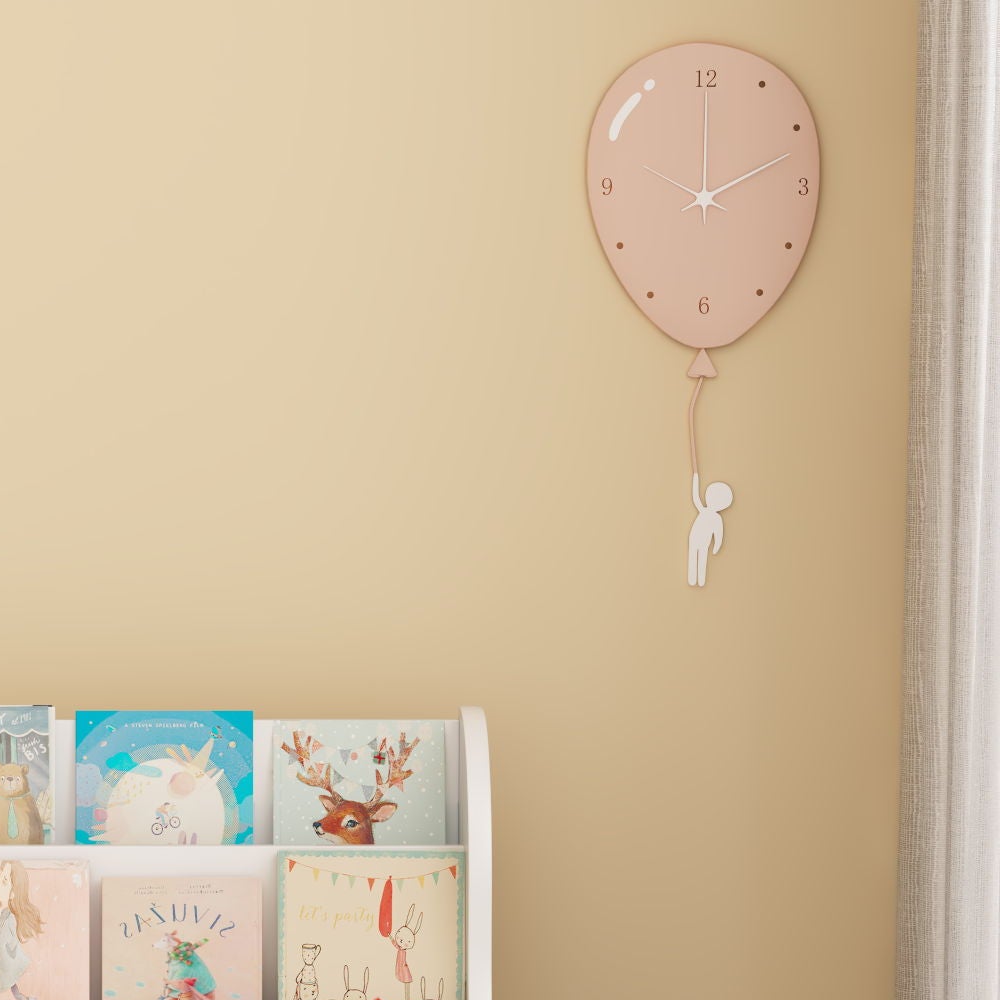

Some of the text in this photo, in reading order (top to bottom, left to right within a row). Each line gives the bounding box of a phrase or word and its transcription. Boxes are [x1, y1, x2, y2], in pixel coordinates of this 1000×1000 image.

[695, 69, 717, 88] 12
[601, 177, 613, 196] 9
[798, 177, 809, 196] 3
[698, 296, 710, 315] 6
